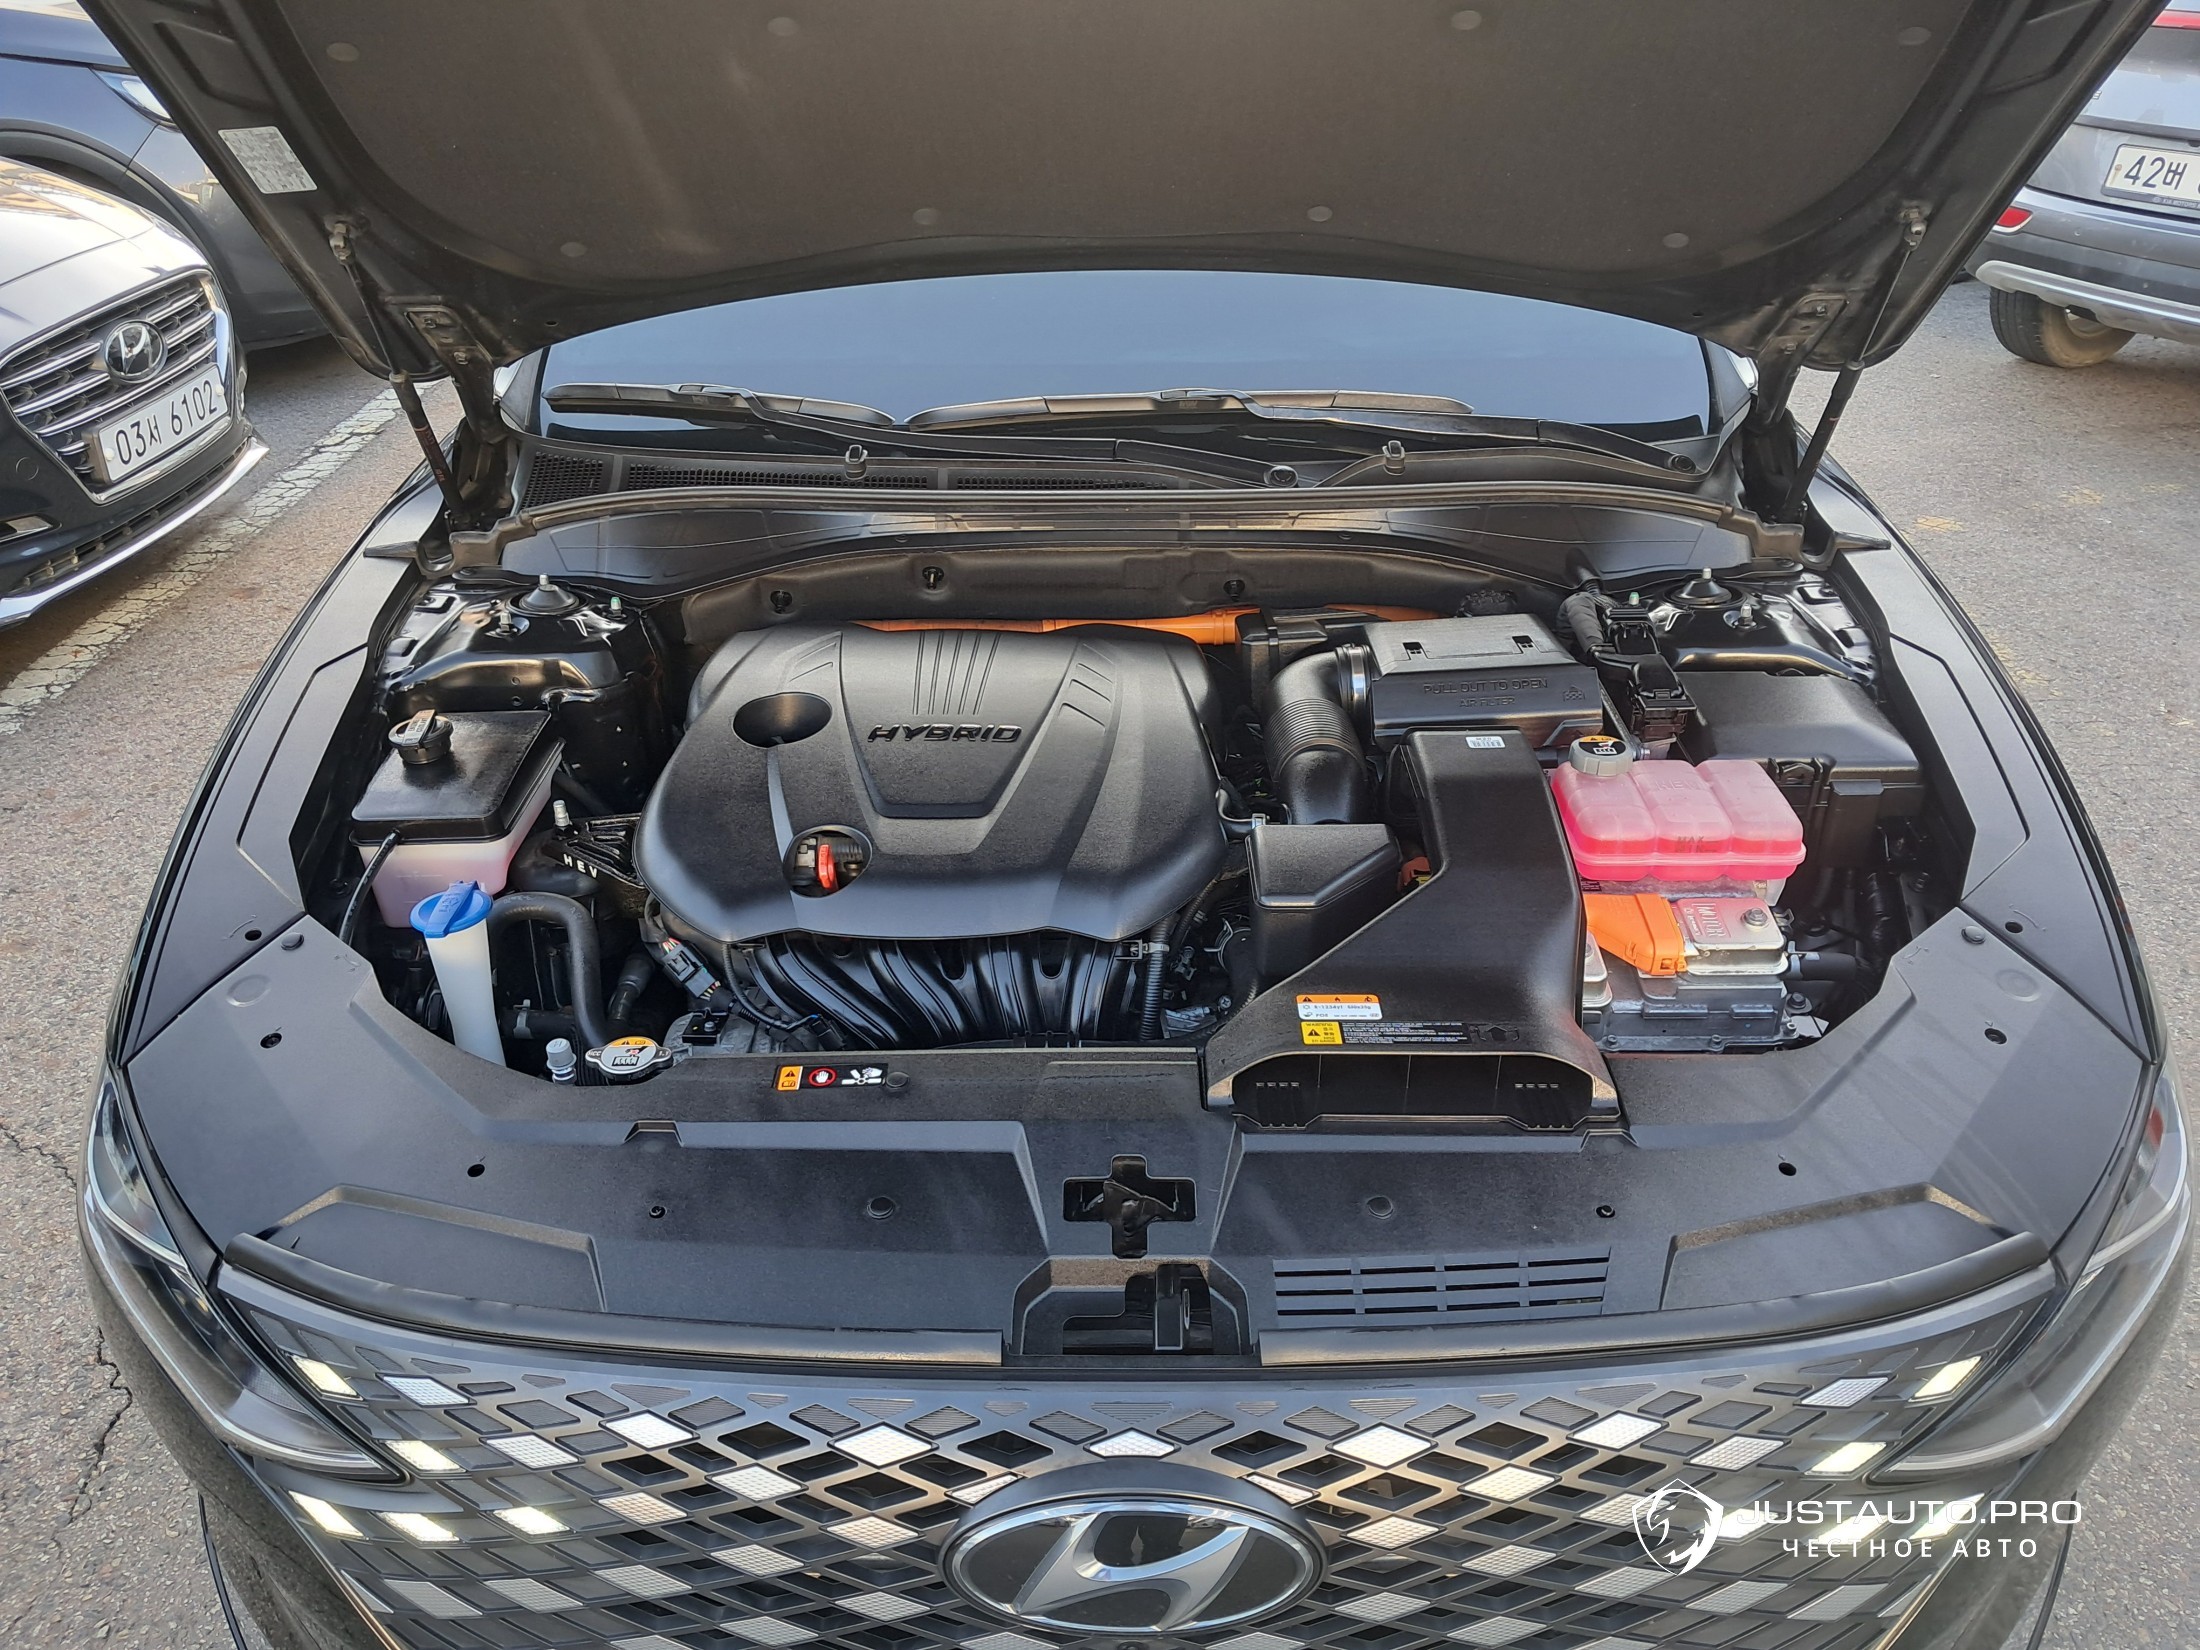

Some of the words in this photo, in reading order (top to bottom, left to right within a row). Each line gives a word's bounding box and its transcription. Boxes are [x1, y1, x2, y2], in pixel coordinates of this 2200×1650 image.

[2124, 155, 2188, 190] 42버
[115, 414, 162, 465] 03서
[171, 380, 217, 435] 6102
[1423, 683, 1457, 694] PULL
[1460, 681, 1485, 693] OUT
[1491, 679, 1508, 690] TO
[1512, 677, 1548, 690] OPEN
[1459, 698, 1476, 708] AIR
[1480, 695, 1515, 707] FILTER
[867, 723, 1022, 743] HYBRID
